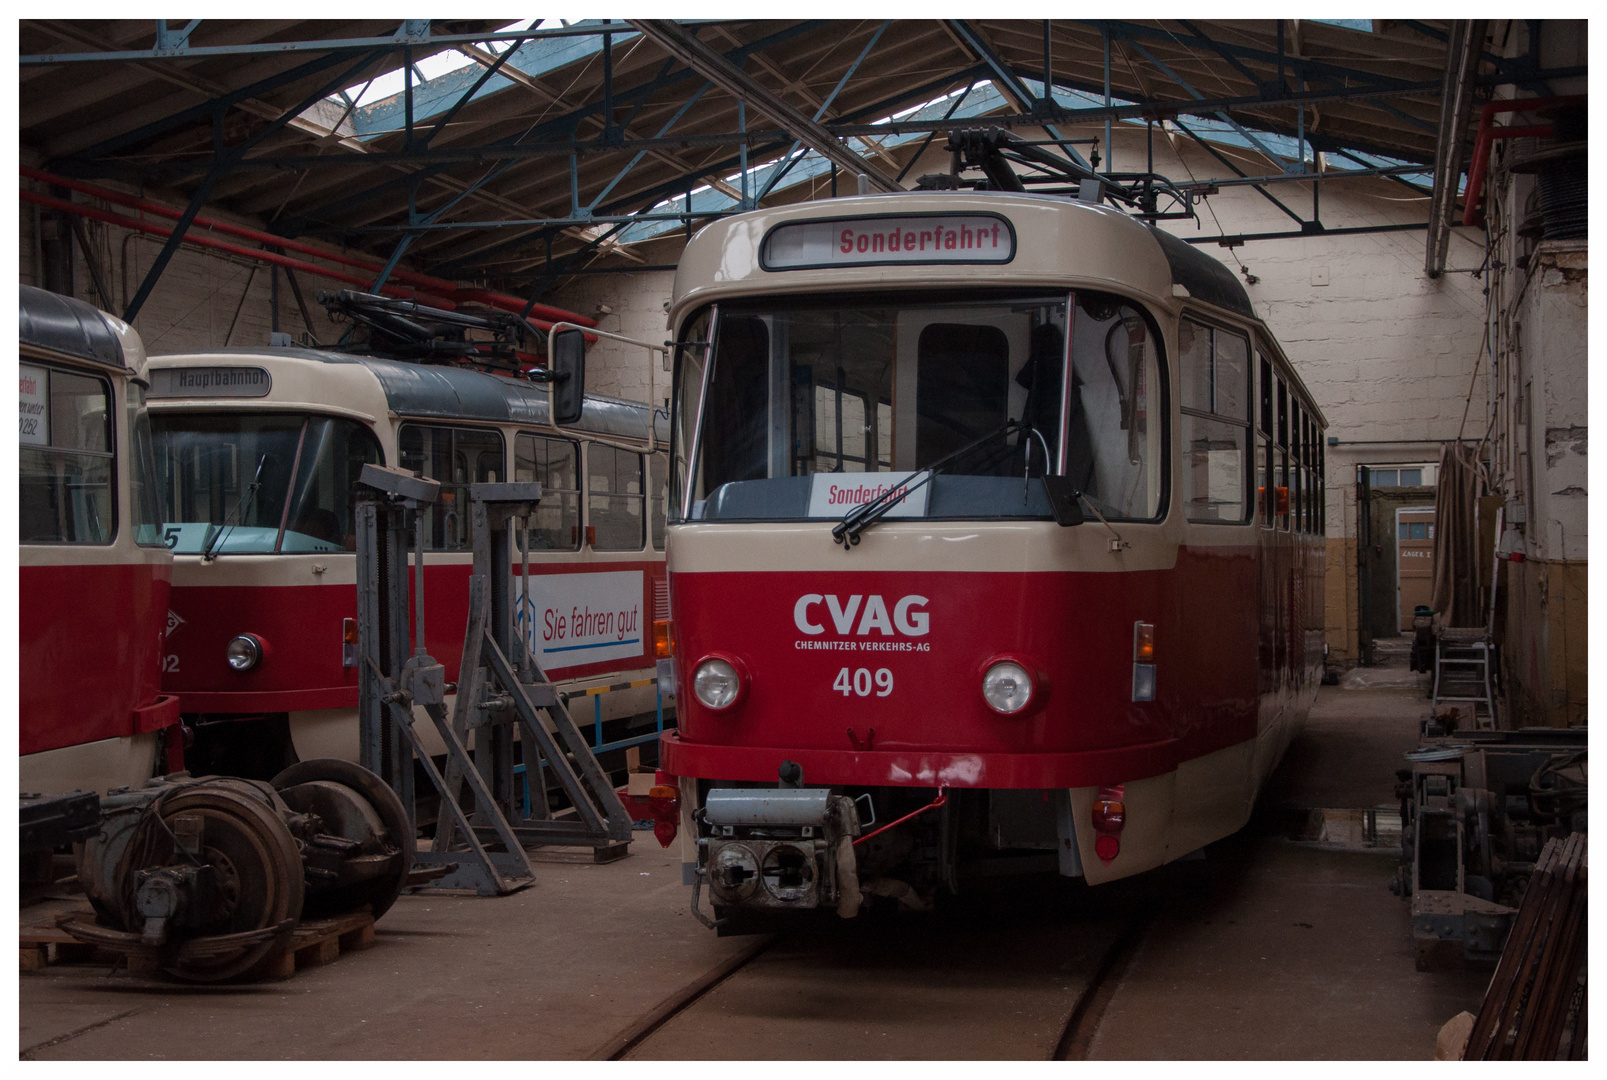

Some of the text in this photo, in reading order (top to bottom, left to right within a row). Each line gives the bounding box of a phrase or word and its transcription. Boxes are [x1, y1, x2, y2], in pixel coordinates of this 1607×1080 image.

[840, 222, 1000, 254] Sonderfahrt
[179, 369, 264, 388] Hauptbahnhof
[543, 608, 567, 641] Sie
[571, 606, 614, 638] fahren
[617, 604, 638, 641] gut
[793, 593, 930, 637] CVAG
[794, 640, 931, 652] CHEMNITZER VERKEHRS-AG
[832, 667, 894, 698] 409
